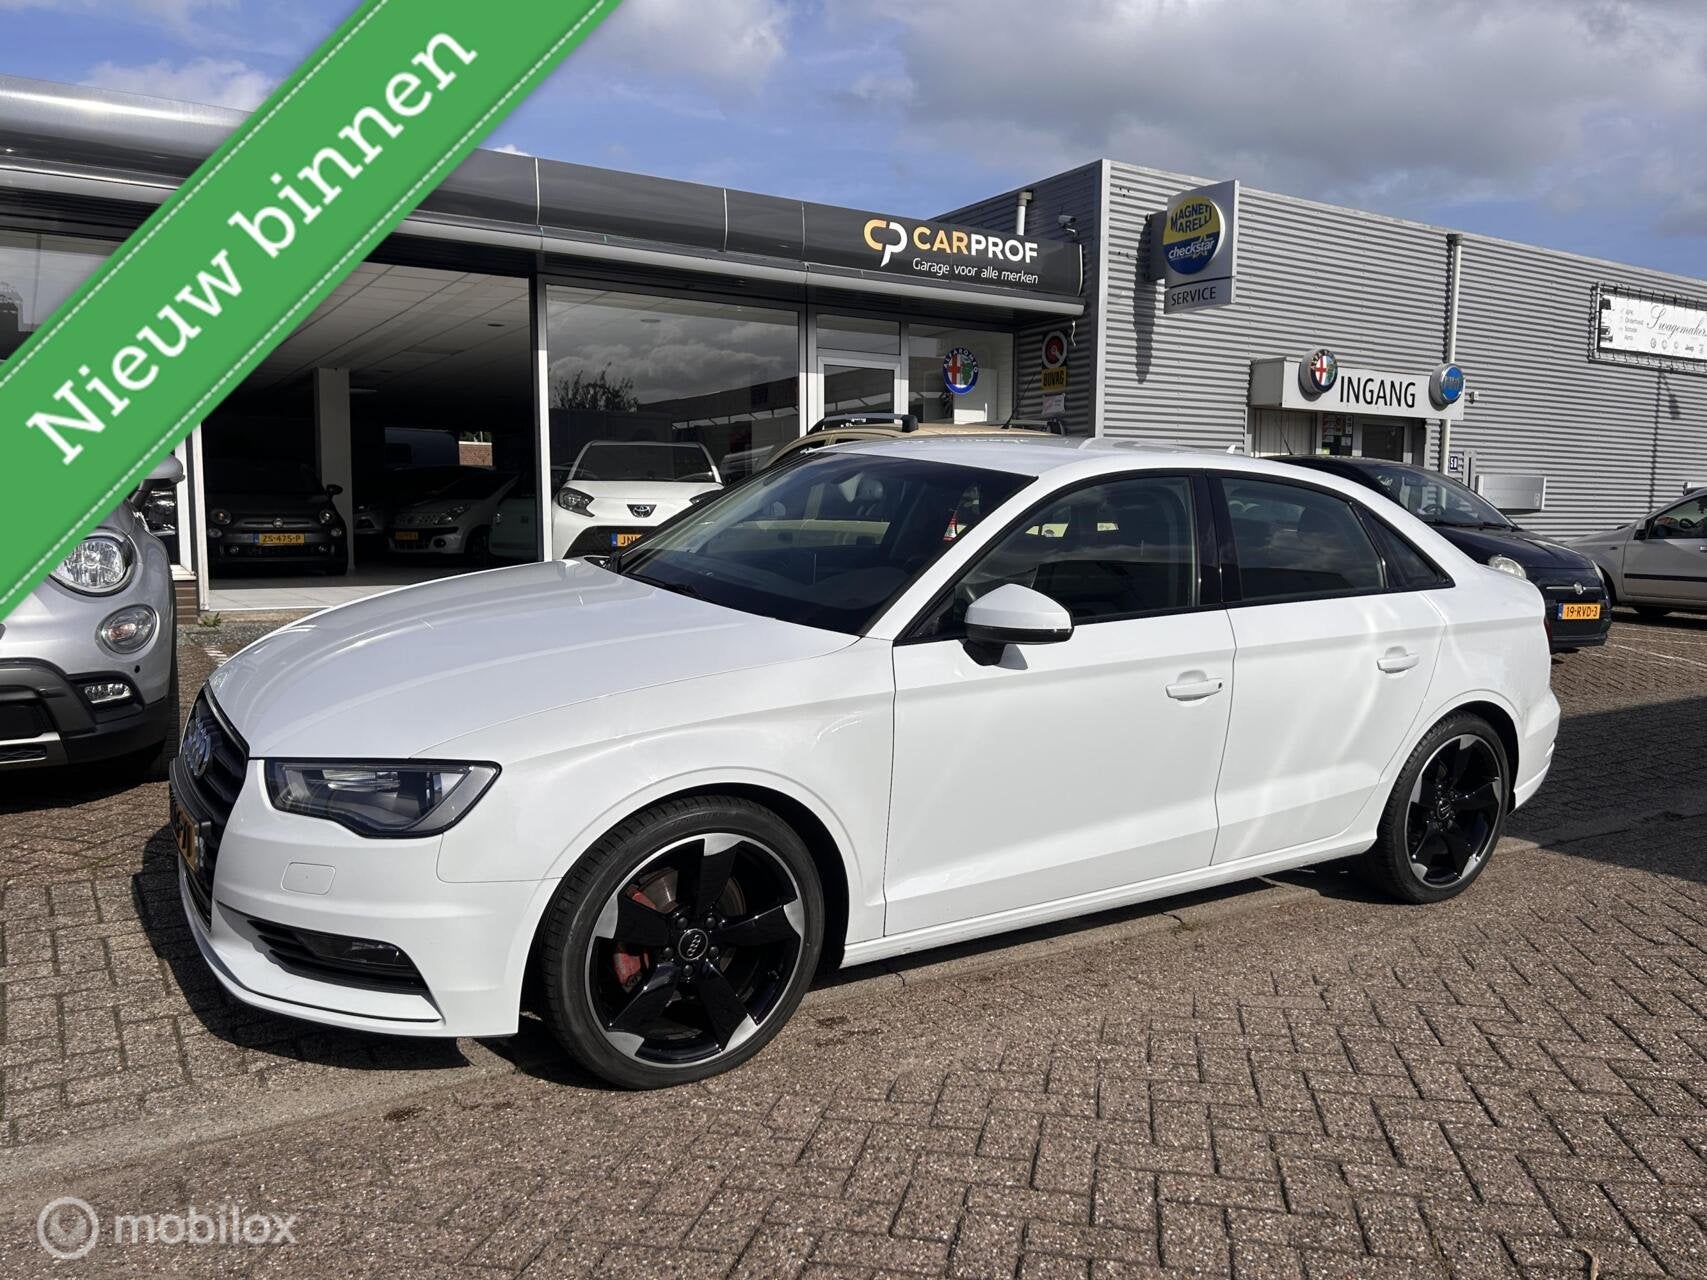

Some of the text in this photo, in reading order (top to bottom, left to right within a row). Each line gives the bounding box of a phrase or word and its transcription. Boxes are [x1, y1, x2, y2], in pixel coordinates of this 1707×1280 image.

[912, 226, 1039, 263] CARPROF
[1168, 240, 1215, 259] checkstar
[912, 257, 1039, 284] Garage voor alle merken
[1171, 286, 1217, 306] SERVICE
[1340, 375, 1416, 408] INGANG
[1566, 606, 1598, 618] 19-RVD-3
